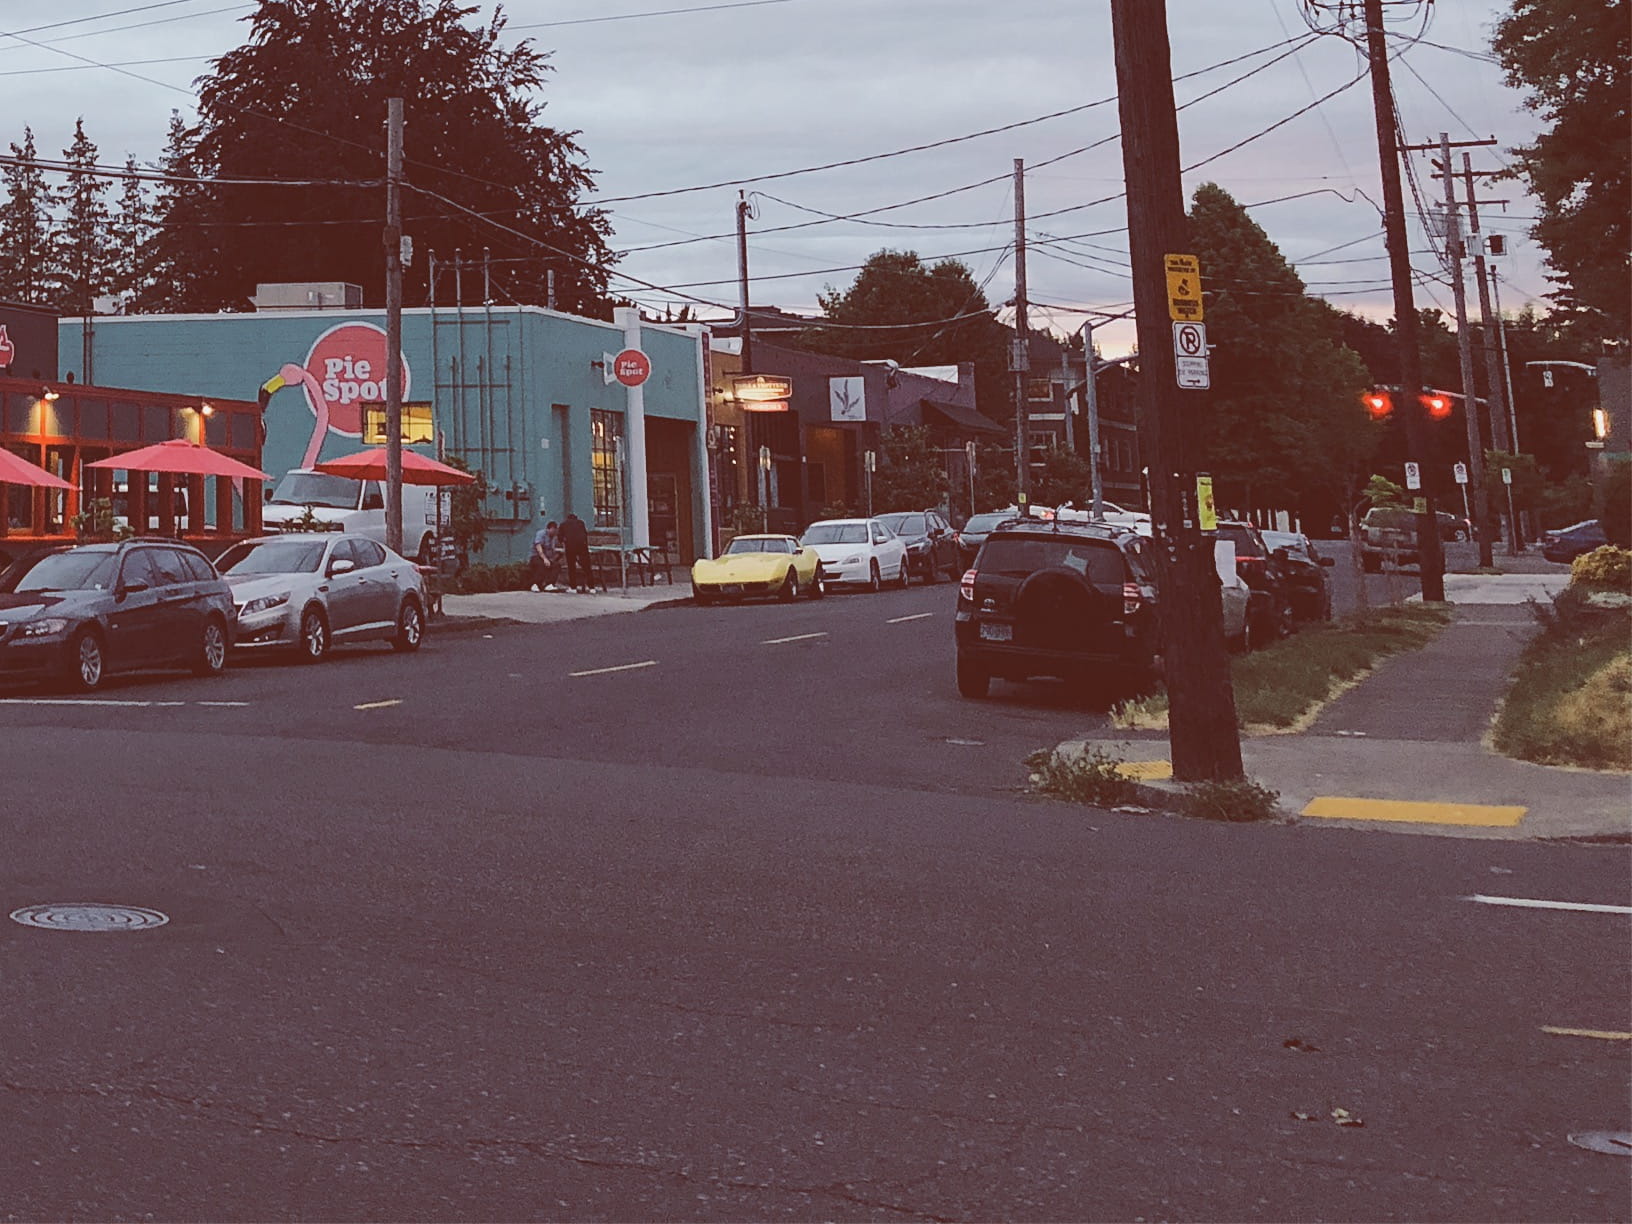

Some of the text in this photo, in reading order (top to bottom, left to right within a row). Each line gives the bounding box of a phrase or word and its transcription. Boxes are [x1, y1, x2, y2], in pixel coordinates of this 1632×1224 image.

[324, 355, 371, 380] Pie
[619, 367, 644, 377] Spot
[620, 360, 638, 369] Pie
[322, 377, 387, 404] Spot
